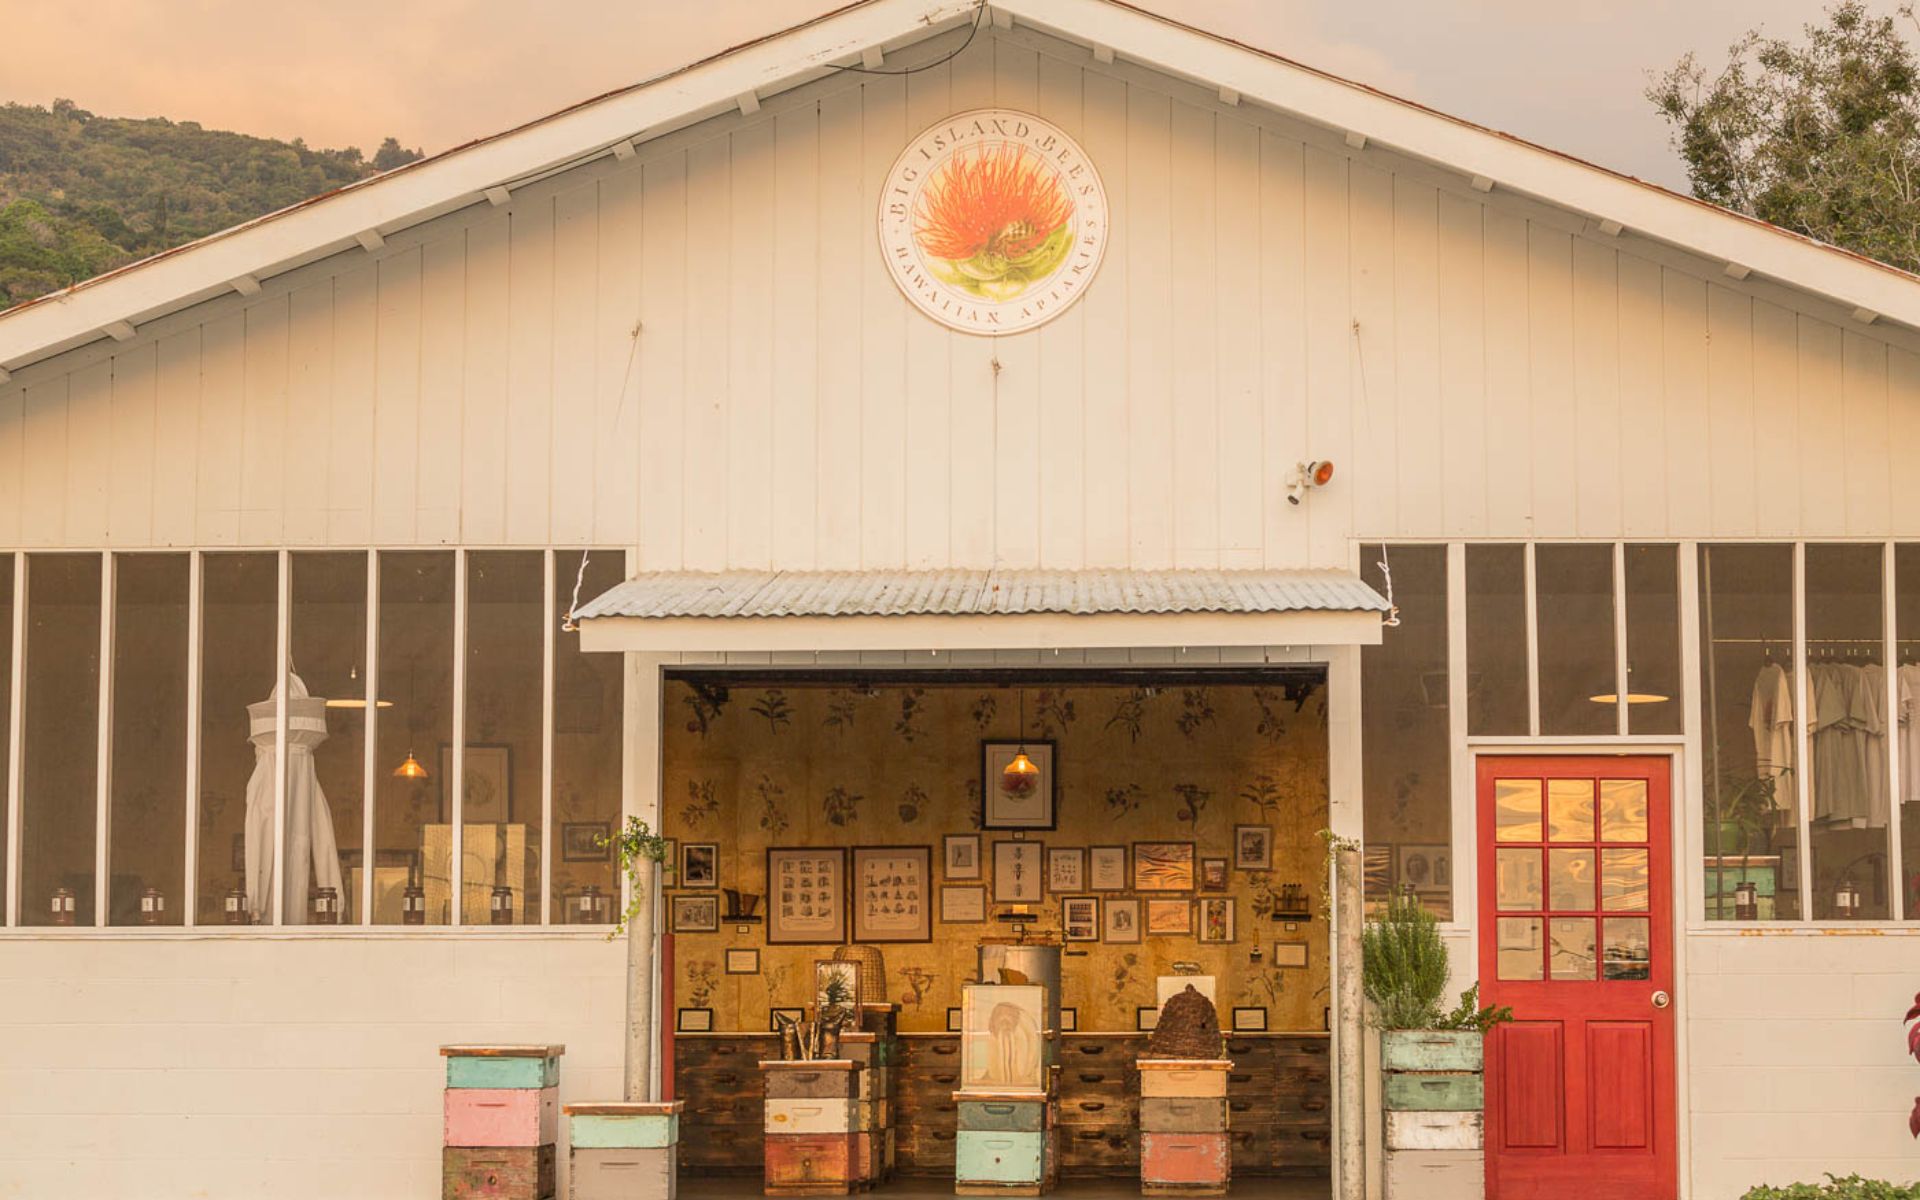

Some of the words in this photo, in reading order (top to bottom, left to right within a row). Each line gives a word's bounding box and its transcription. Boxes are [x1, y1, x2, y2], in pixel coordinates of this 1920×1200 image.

[890, 167, 918, 223] BIG
[920, 119, 1030, 161] ISLAND
[1035, 134, 1095, 196] BEES
[896, 247, 1000, 324] HAWAIIAN
[1020, 220, 1096, 319] APIARIES
